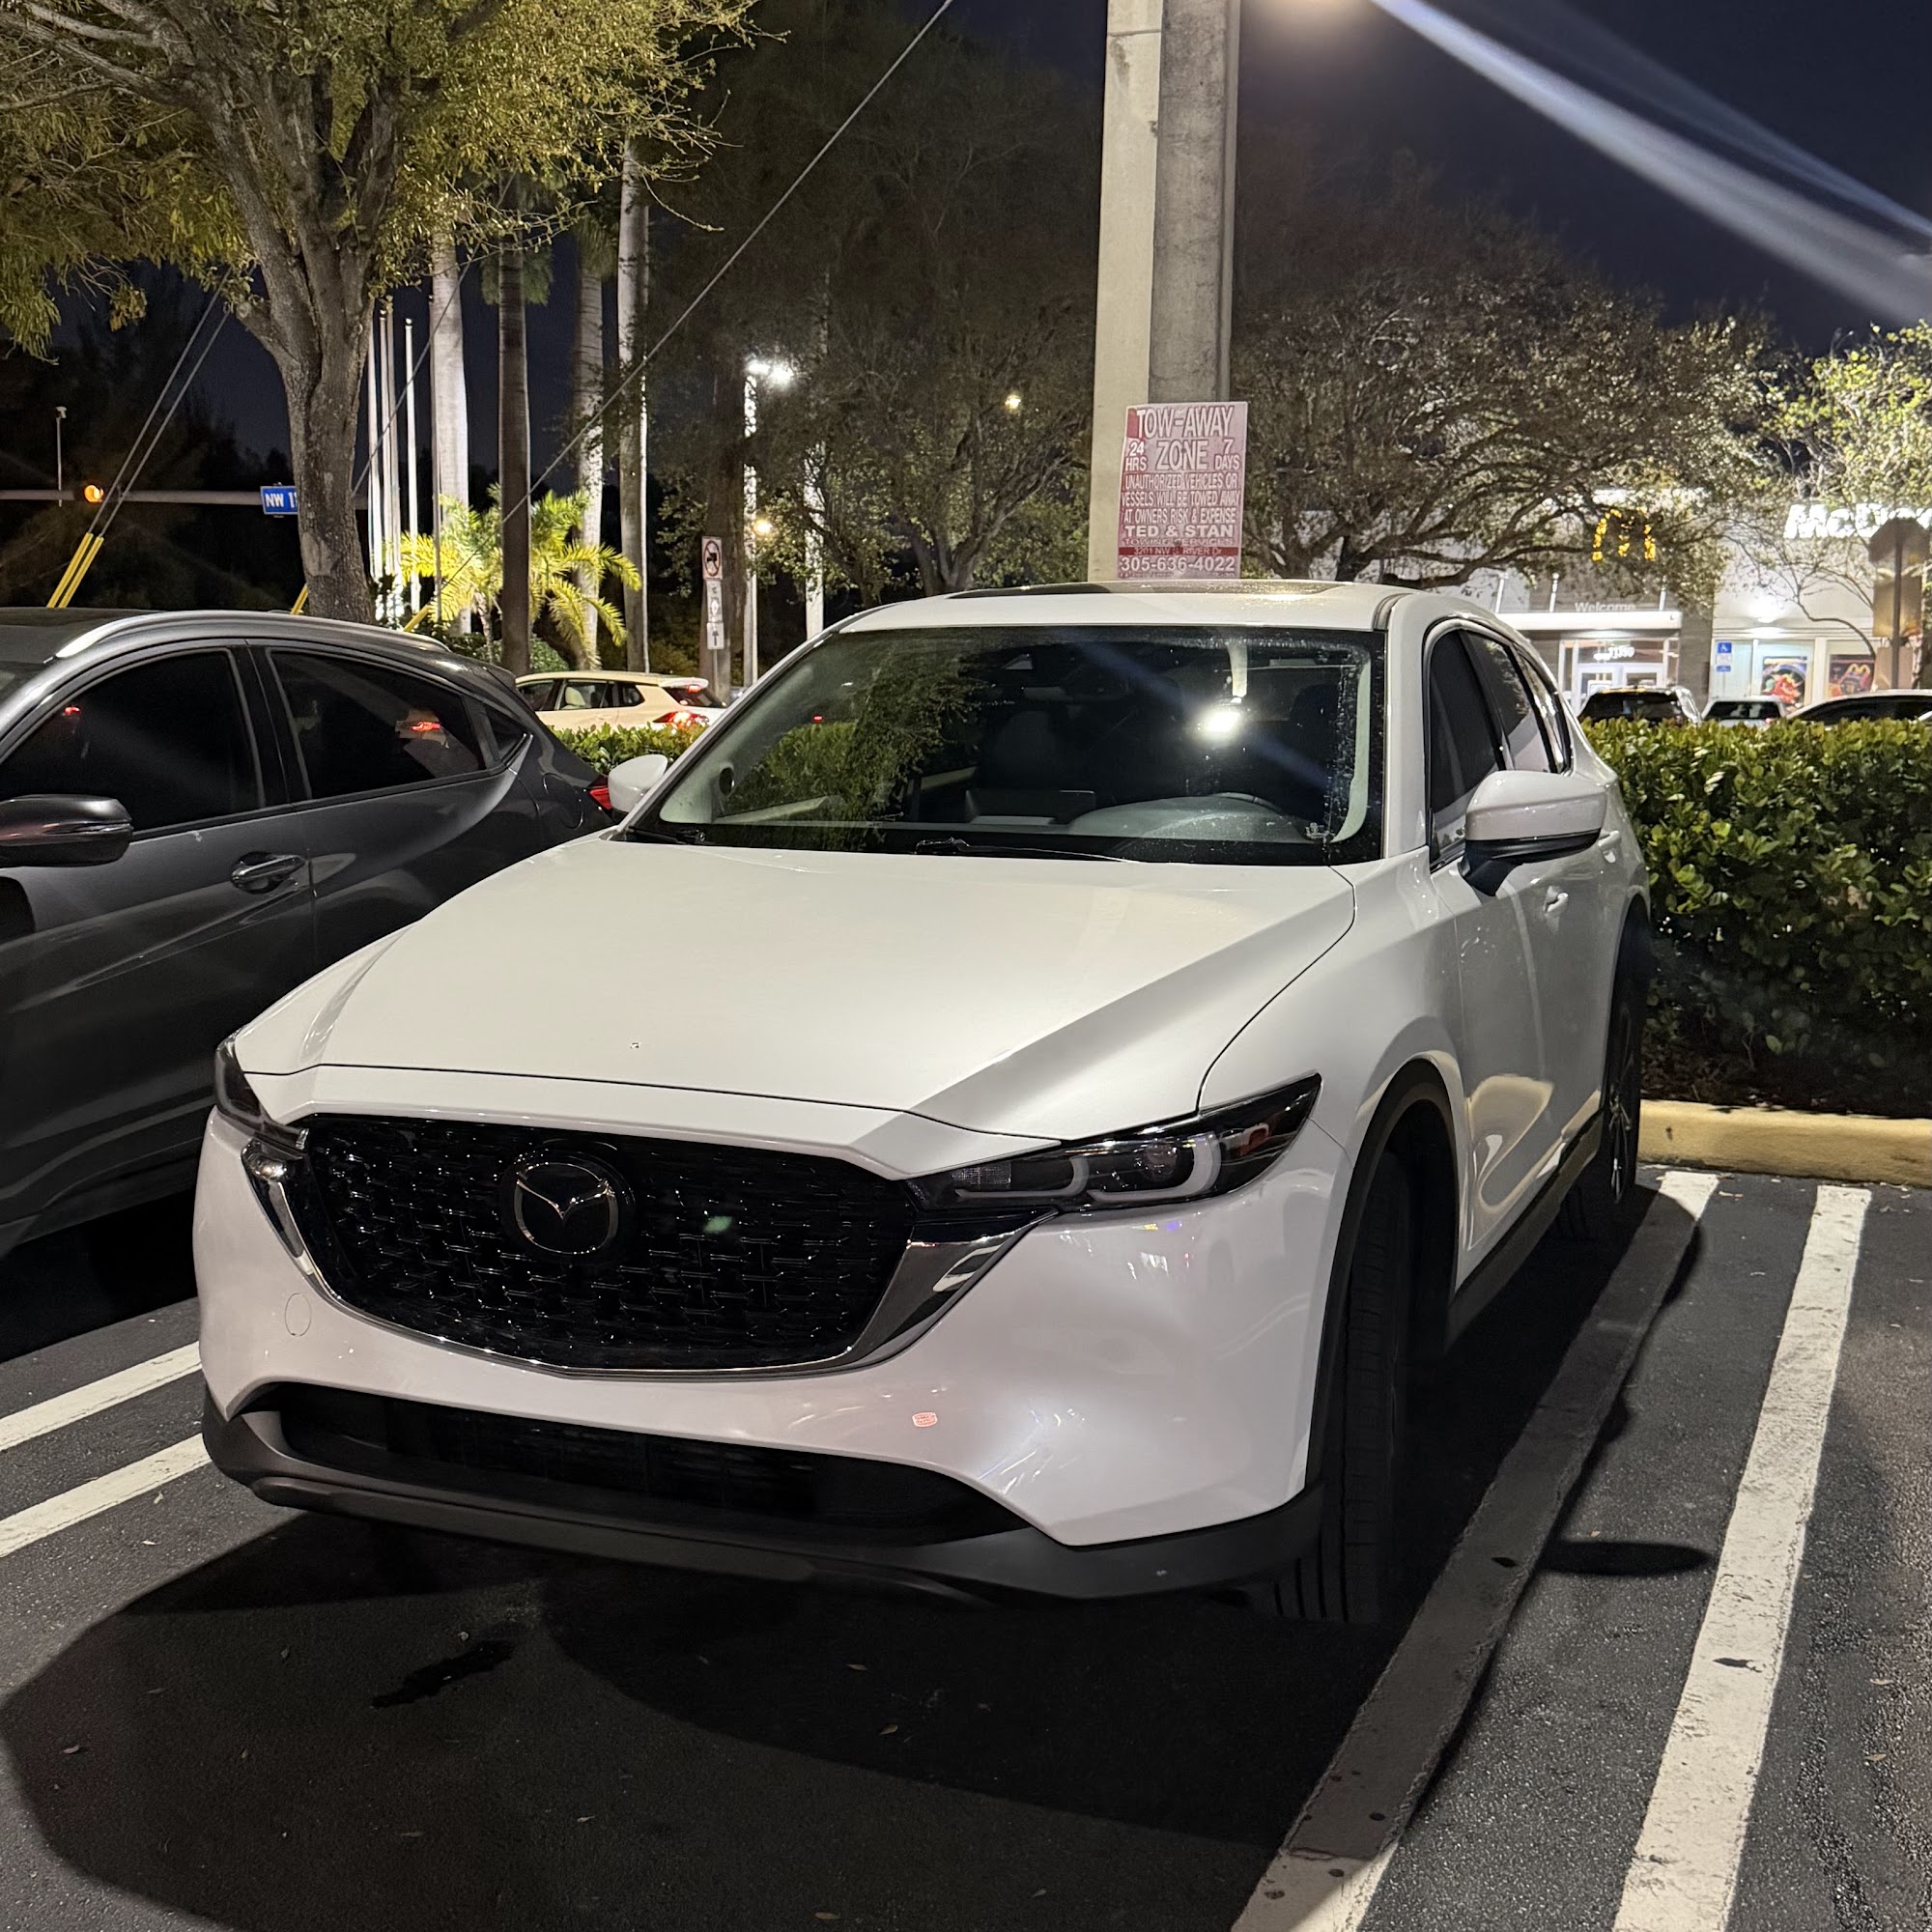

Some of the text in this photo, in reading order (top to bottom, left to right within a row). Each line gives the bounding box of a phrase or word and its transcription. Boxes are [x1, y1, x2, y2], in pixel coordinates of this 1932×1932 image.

[1136, 407, 1234, 439] TOW-AWAY
[1129, 440, 1145, 456] 24
[1223, 439, 1234, 454] 7
[1155, 440, 1208, 471] ZONE
[1214, 454, 1240, 470] DAYS
[1125, 457, 1147, 471] HRS
[1125, 472, 1237, 490] UNAUTHORIZED VEHICLES OR
[265, 493, 284, 507] NW
[1122, 490, 1241, 506] VESSELS WILL BE TOWED AWAY
[1123, 508, 1133, 524] AT
[1171, 508, 1189, 524] RISK
[1192, 508, 1198, 524] &
[1200, 507, 1236, 524] EXPENSE
[1124, 525, 1234, 537] TED & STAN
[1154, 547, 1170, 555] NW
[1182, 547, 1209, 555] RIVER
[1121, 556, 1236, 572] 305-636-4022
[1575, 602, 1636, 612] Welcome
